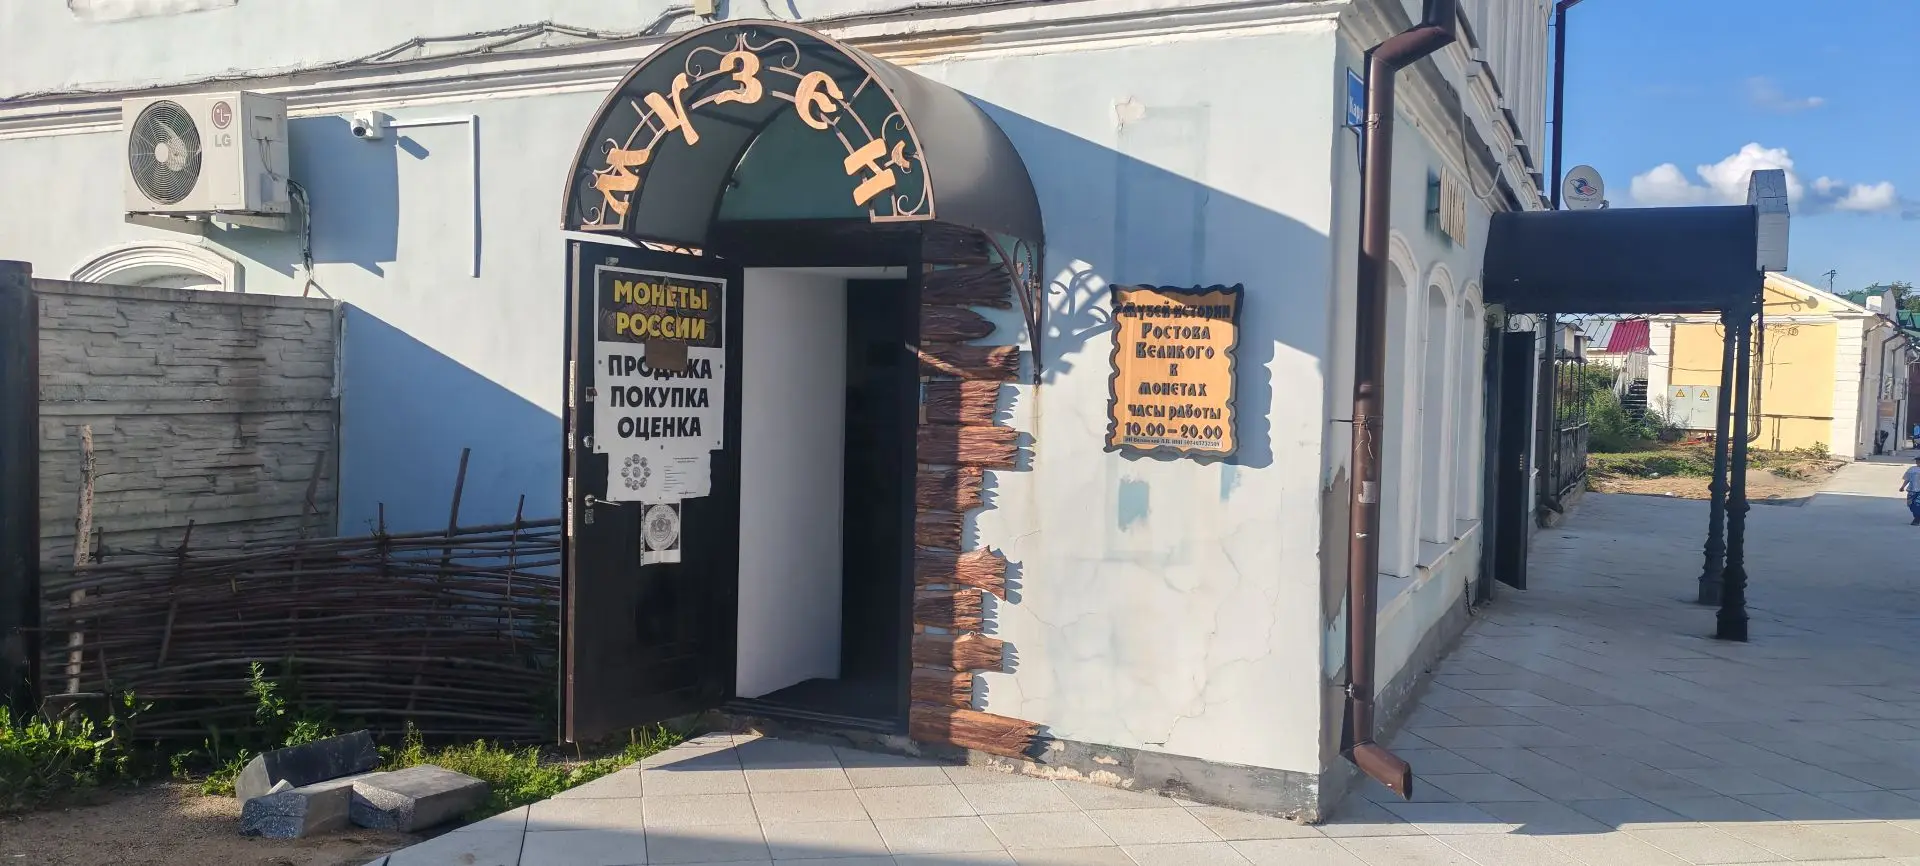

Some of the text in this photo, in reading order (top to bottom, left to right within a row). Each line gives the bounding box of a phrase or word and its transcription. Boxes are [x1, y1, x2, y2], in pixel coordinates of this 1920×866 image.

[214, 133, 232, 147] LG
[596, 51, 911, 216] МУЗЕЙ
[614, 280, 708, 311] МОНЕТЫ
[616, 312, 706, 340] РОССИИ
[1141, 322, 1211, 340] Ростова
[1136, 341, 1215, 360] Великого
[608, 354, 712, 381] ПРОЖА
[610, 386, 709, 408] ПОКУПКА
[1127, 403, 1221, 420] часы работы
[617, 416, 702, 441] ОЦЕНКА
